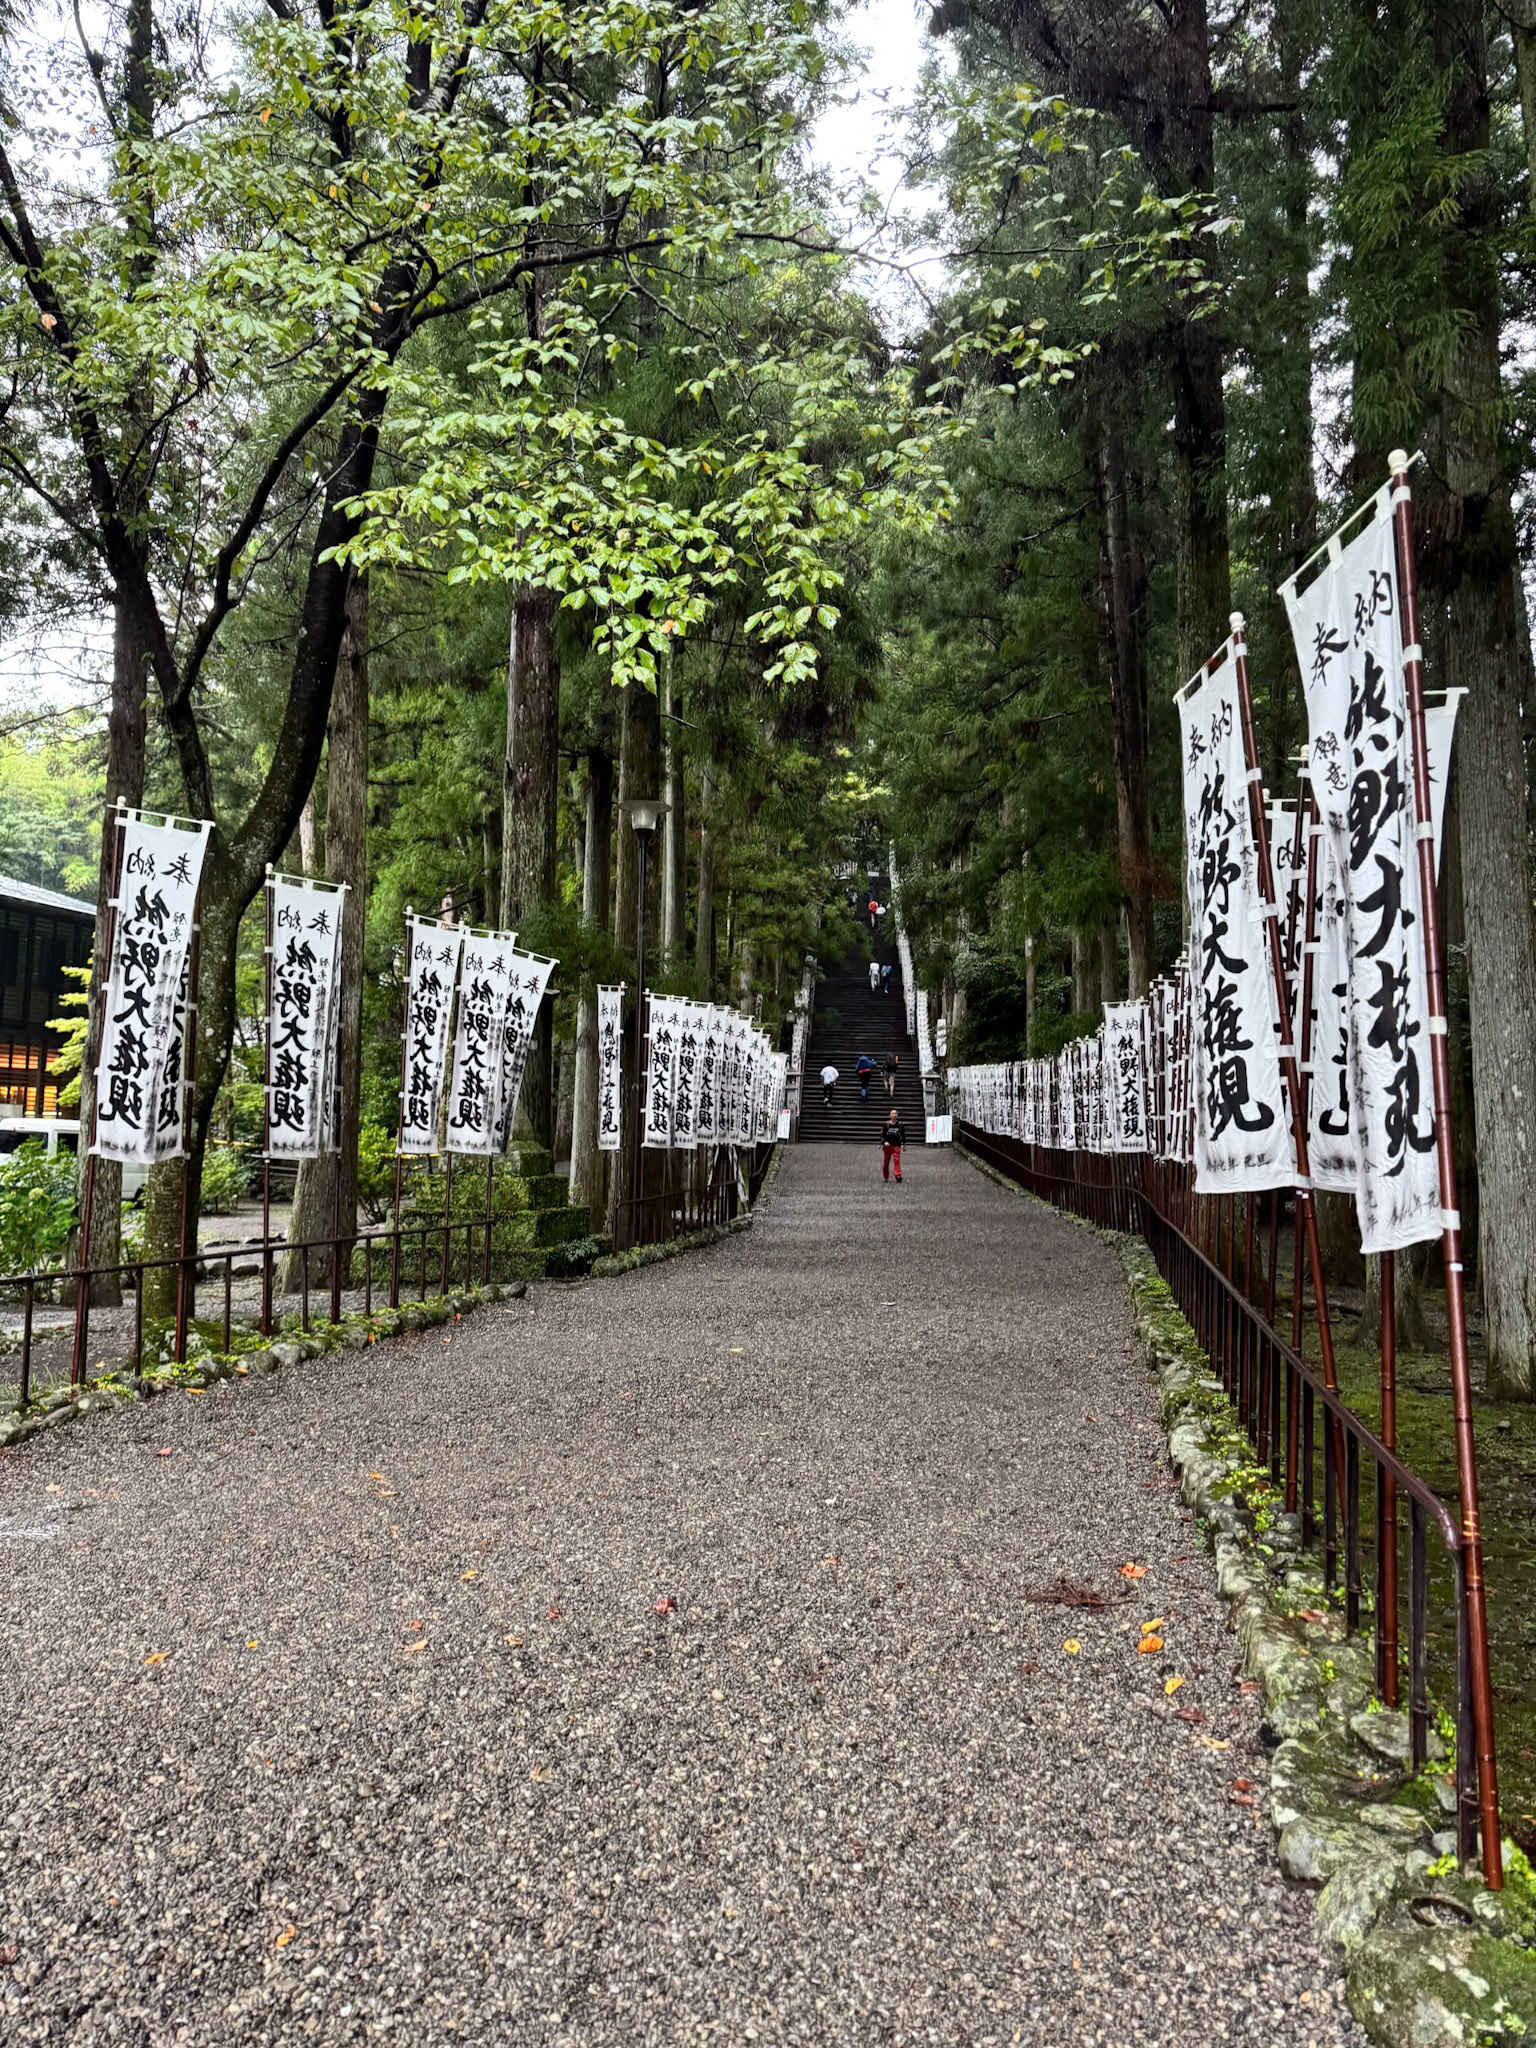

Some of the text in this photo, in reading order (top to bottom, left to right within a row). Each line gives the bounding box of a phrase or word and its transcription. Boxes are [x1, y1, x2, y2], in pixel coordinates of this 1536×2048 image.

[1309, 570, 1394, 690] 奉納
[1186, 699, 1232, 776] 奉納
[1313, 730, 1348, 796] 願意
[1198, 764, 1274, 1142] 熊野大権現
[1109, 1017, 1139, 1032] 奉納
[1117, 1034, 1144, 1139] 熊野大権現
